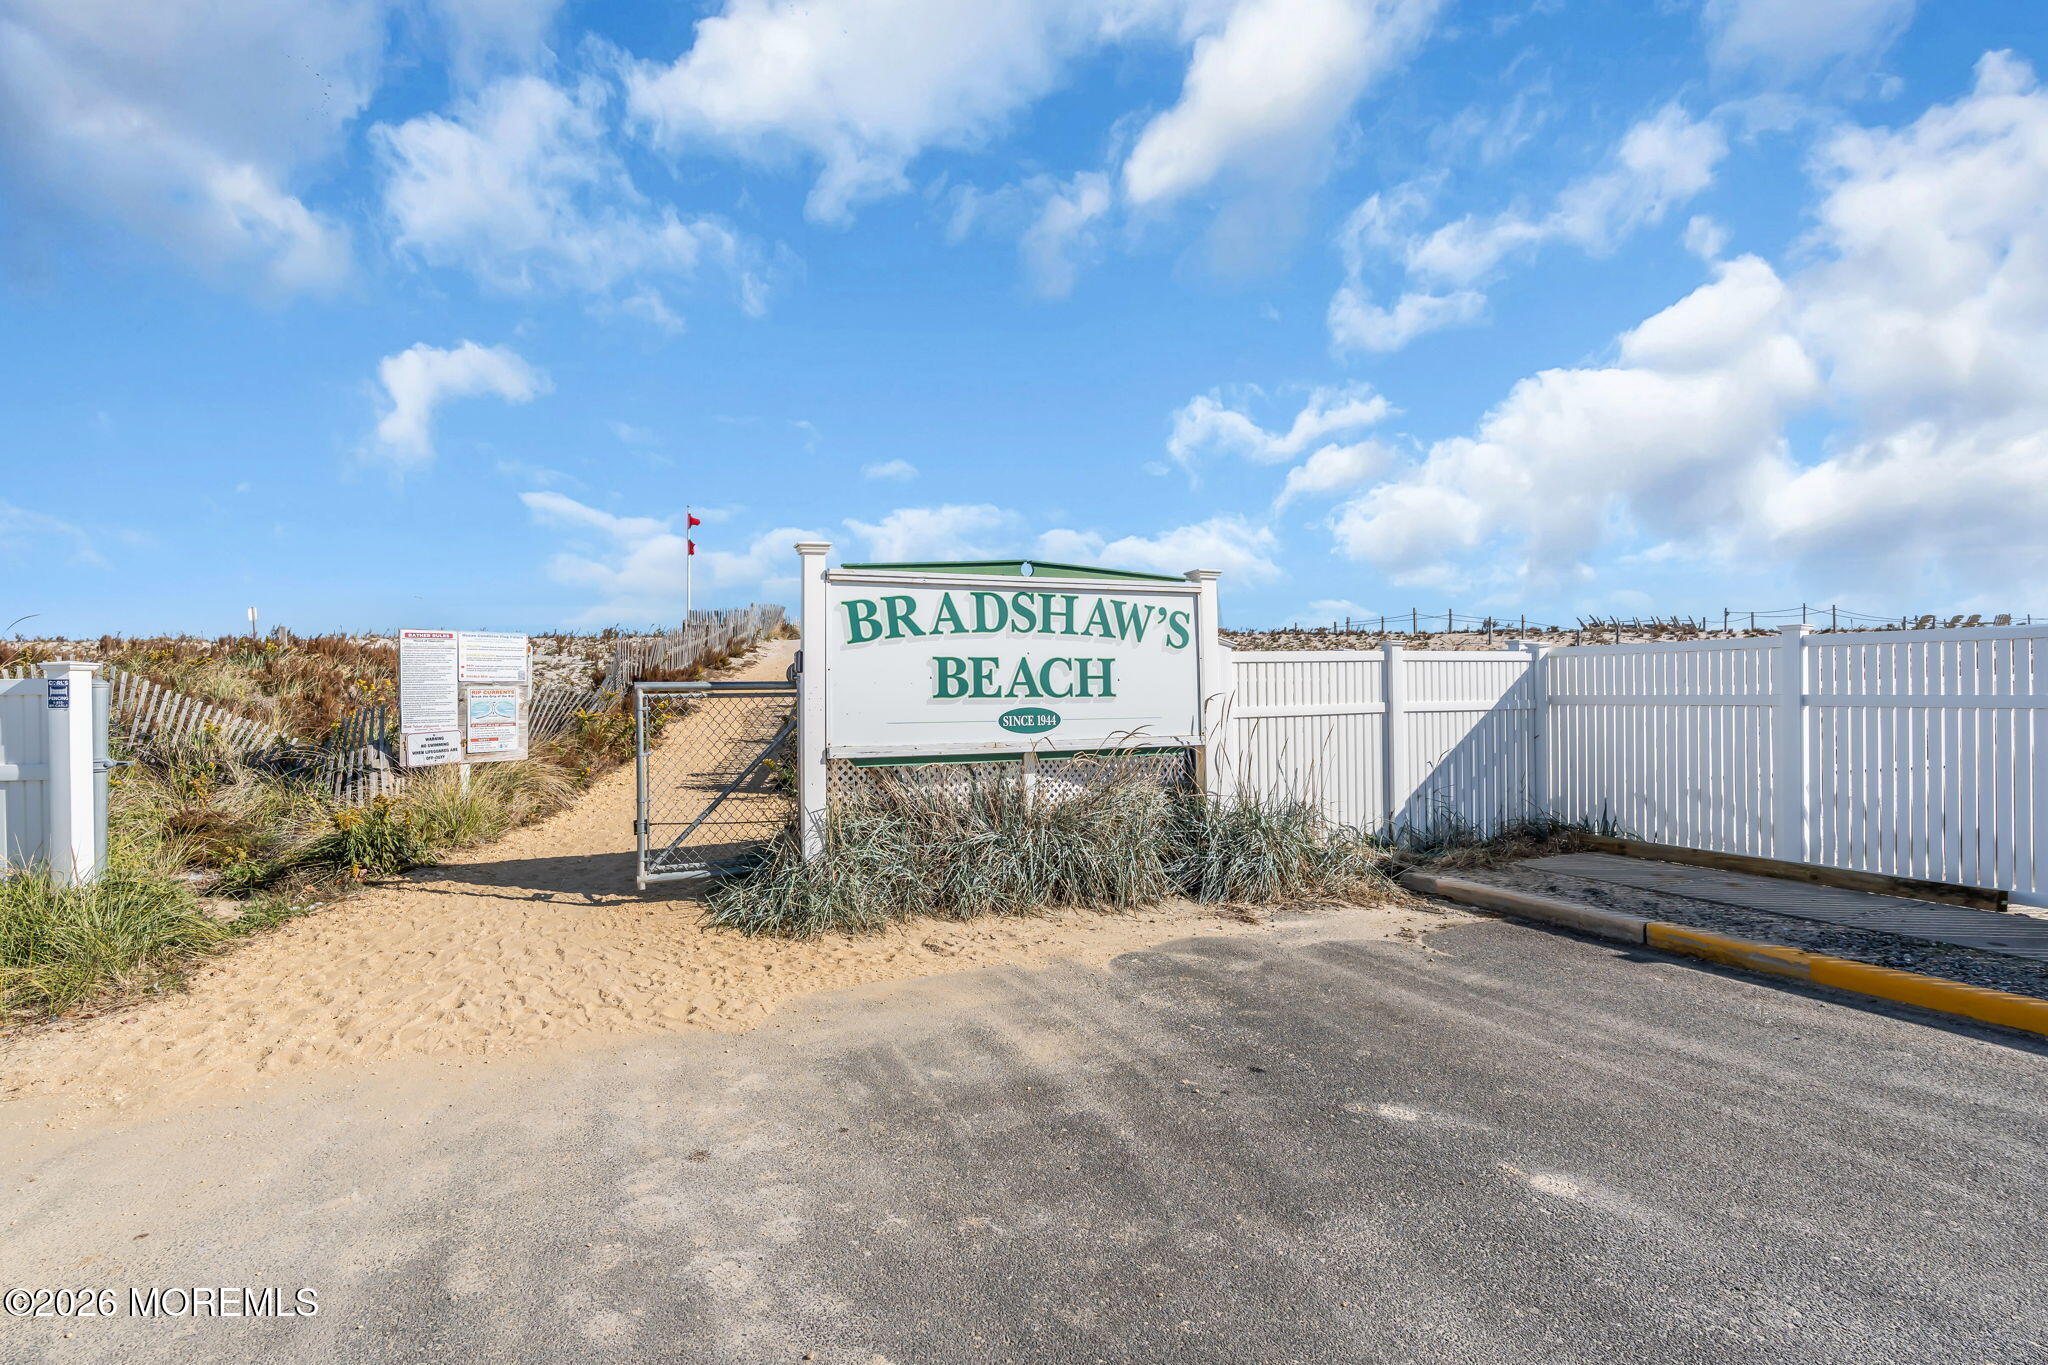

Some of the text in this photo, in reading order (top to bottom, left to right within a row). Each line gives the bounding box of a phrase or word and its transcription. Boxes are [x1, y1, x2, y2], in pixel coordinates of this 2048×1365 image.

[841, 592, 1190, 650] BRADSHAW'S
[931, 656, 1117, 699] BEACH
[1002, 714, 1057, 727] SINCE 1944
